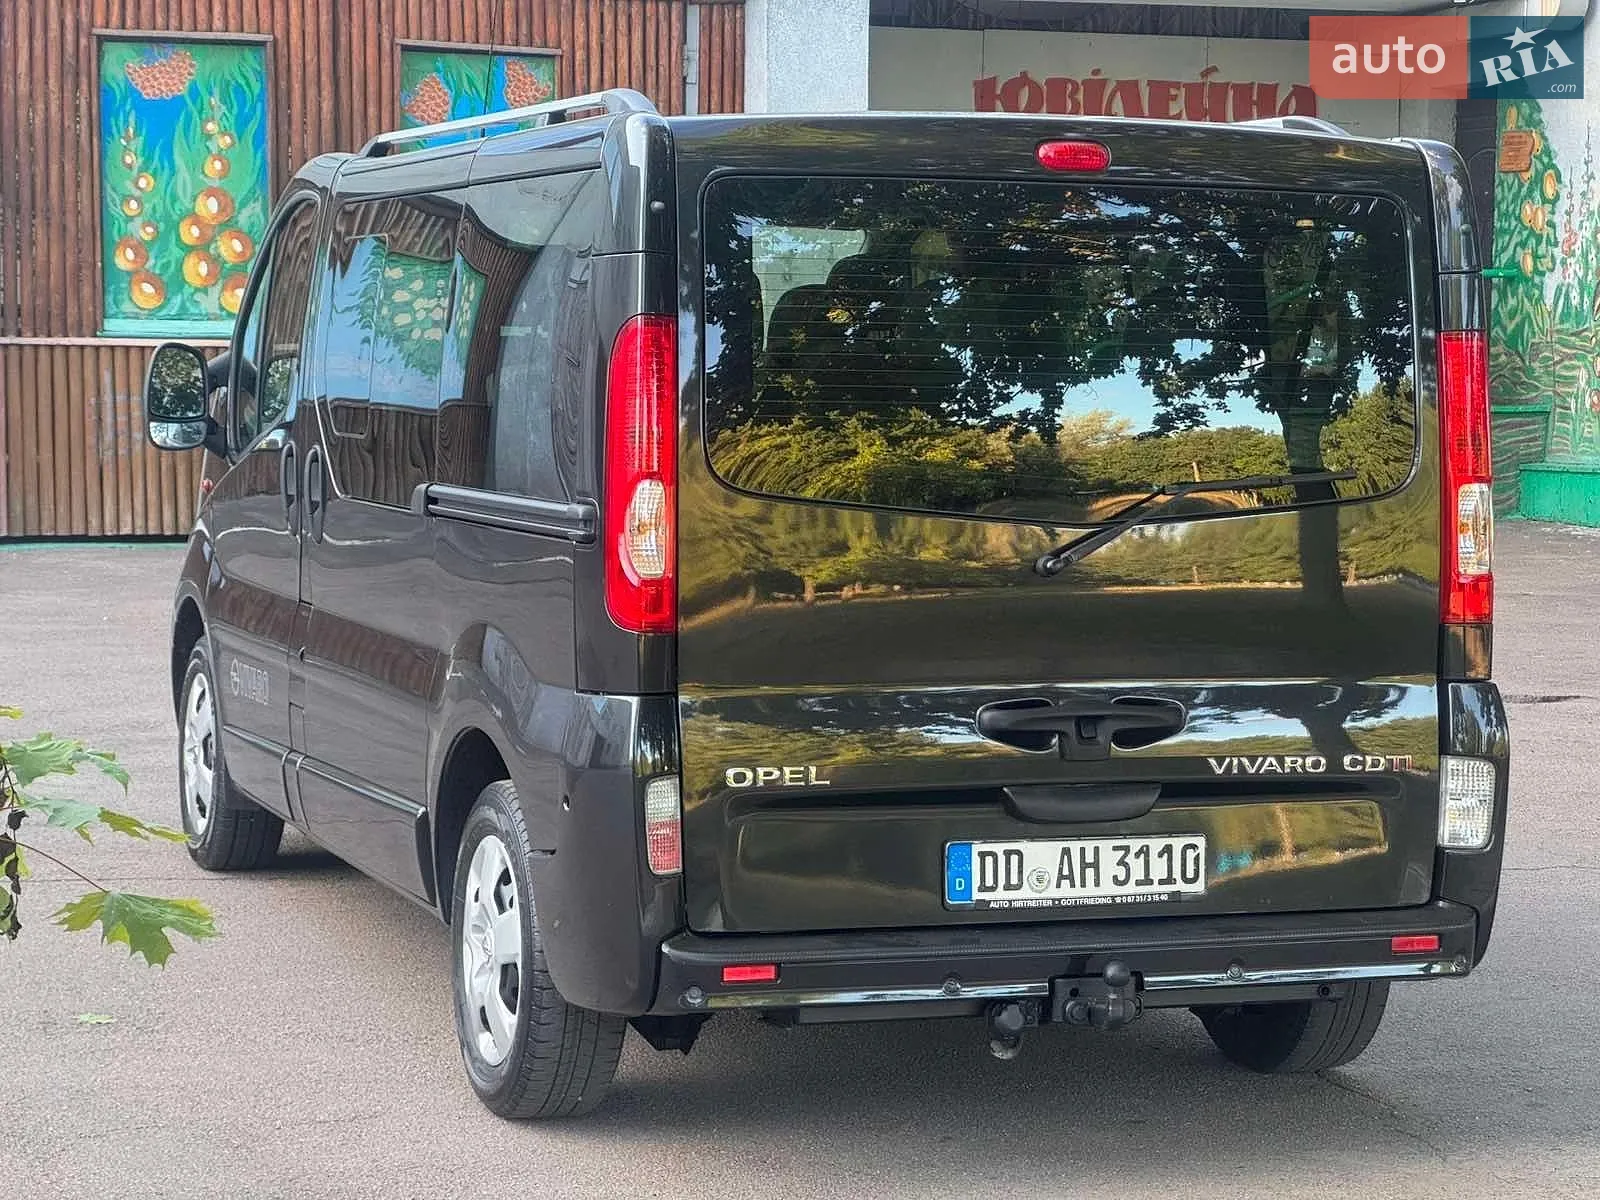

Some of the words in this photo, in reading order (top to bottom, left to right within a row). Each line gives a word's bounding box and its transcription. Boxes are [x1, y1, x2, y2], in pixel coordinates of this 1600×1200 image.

[1207, 755, 1327, 775] VIVARO
[725, 765, 831, 788] OPEL
[977, 849, 1024, 893] DD
[1055, 846, 1101, 889] AH
[1112, 843, 1200, 887] 3110
[955, 878, 965, 891] D
[989, 900, 1009, 908] AUTO
